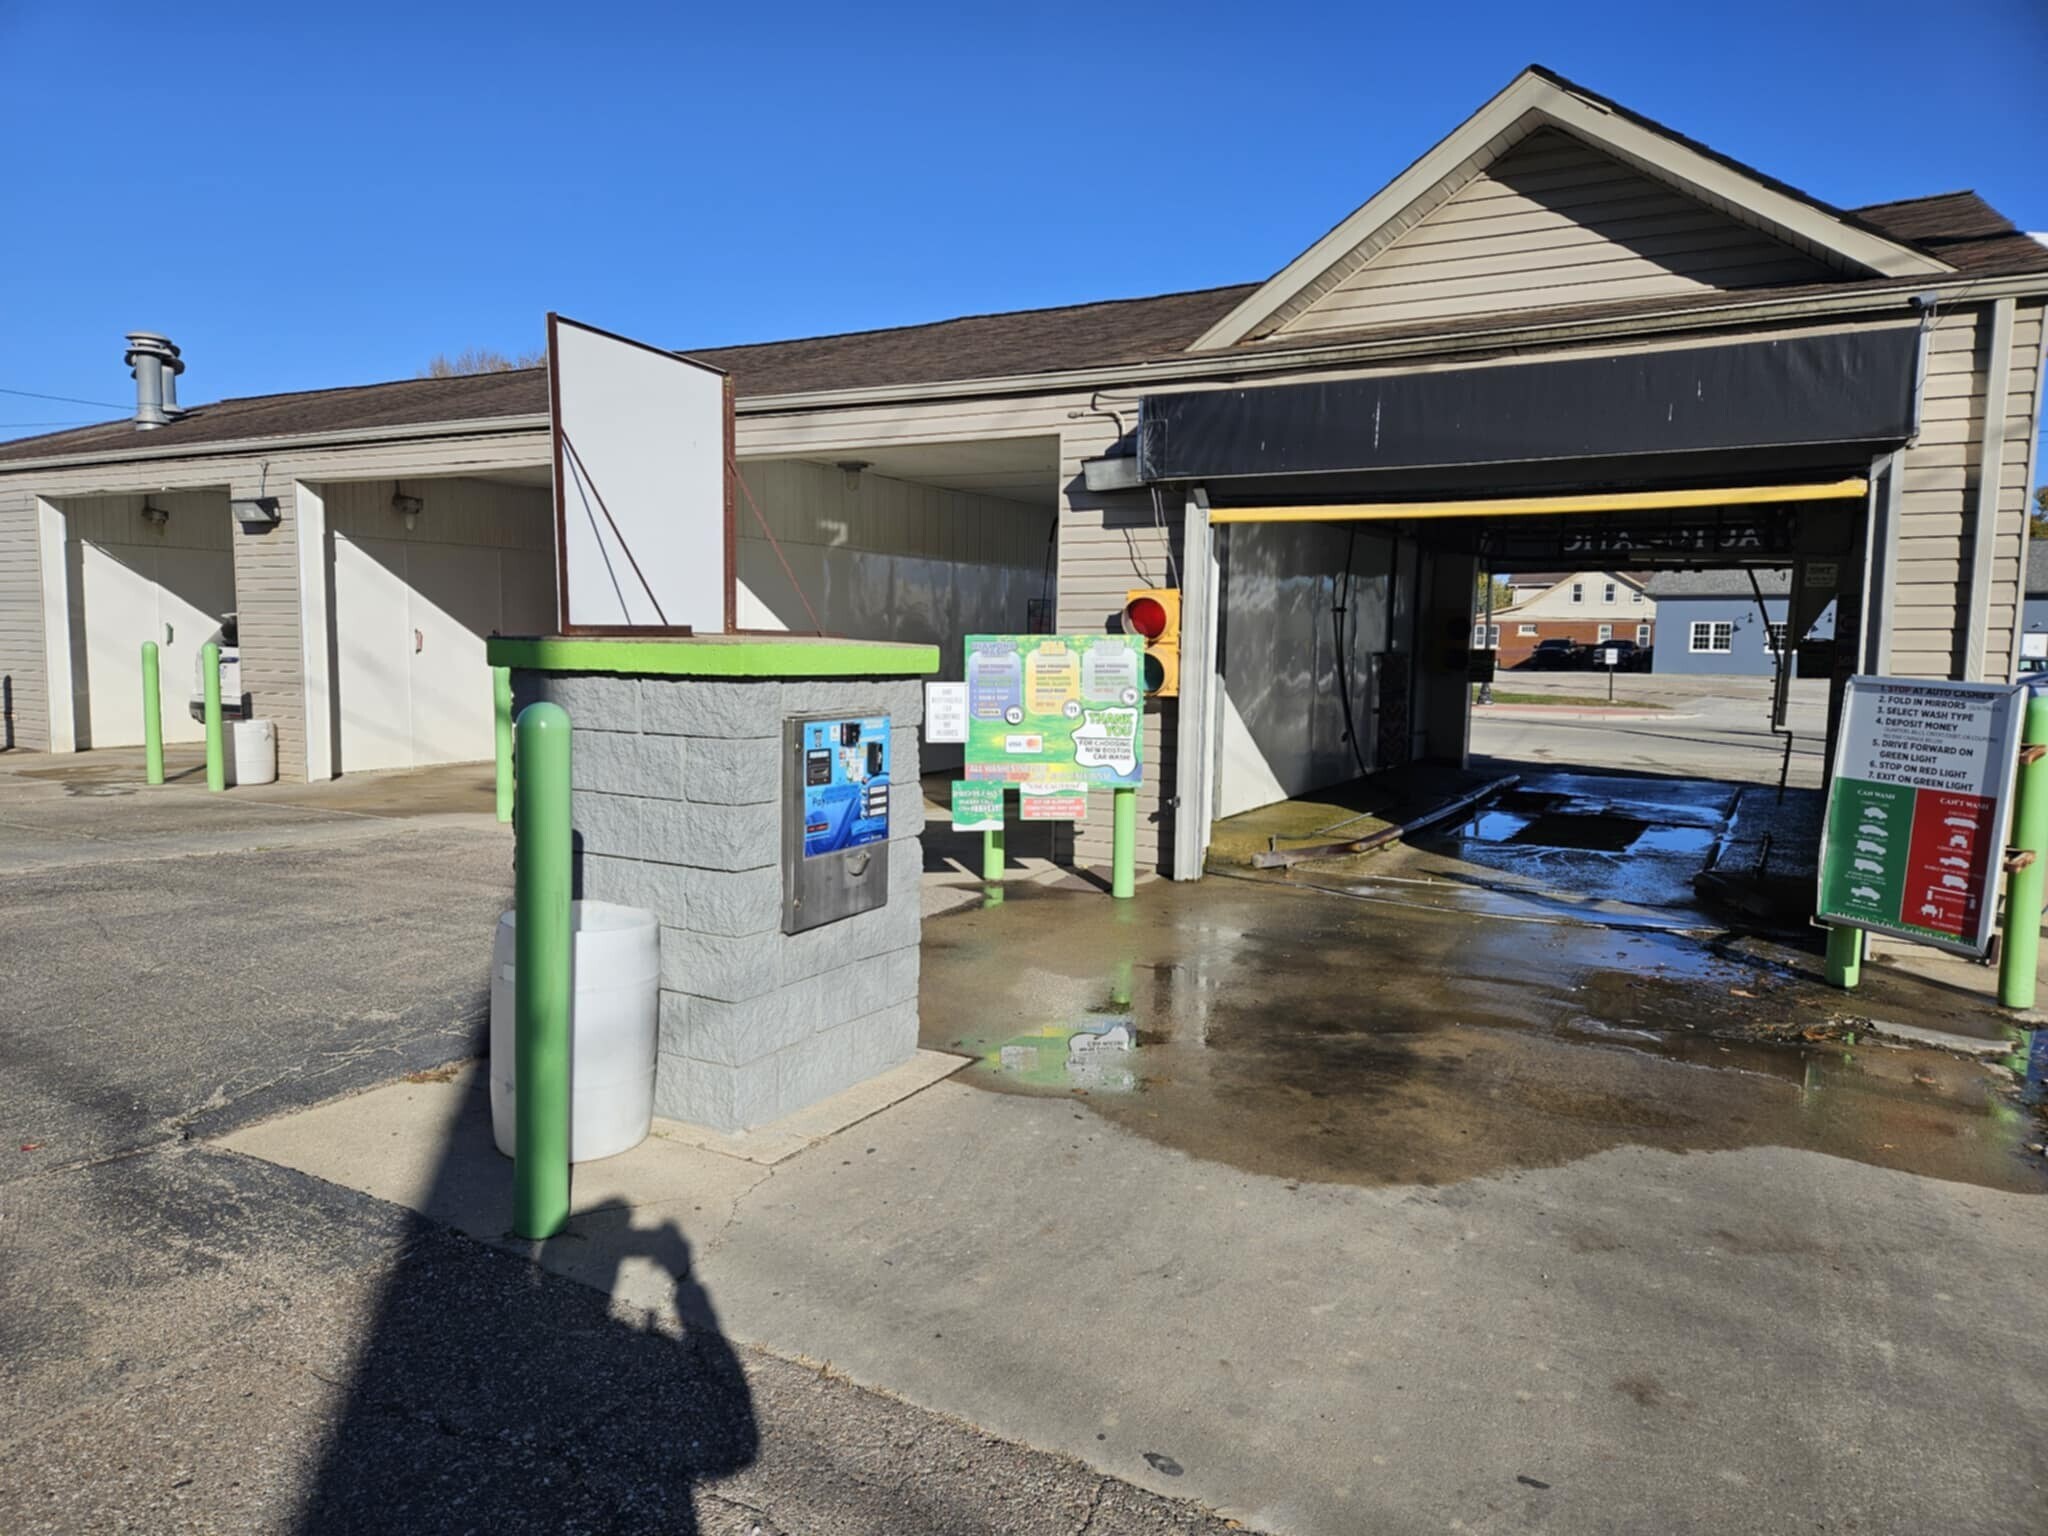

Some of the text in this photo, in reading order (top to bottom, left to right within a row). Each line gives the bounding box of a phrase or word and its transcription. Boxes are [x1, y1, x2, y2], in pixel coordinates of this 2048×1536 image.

[1888, 686, 1911, 694] STOP
[1912, 688, 1925, 696] AT
[1926, 688, 1952, 698] AUTO
[1953, 690, 1994, 700] CASHIER
[1888, 696, 1912, 706] FOLD
[1913, 698, 1922, 706] IN
[1924, 699, 1966, 710] MIRRORS
[1087, 712, 1134, 725] THANK
[1886, 706, 1918, 718] SELECT
[1920, 710, 1948, 720] WASH
[1950, 712, 1974, 722] TYPE
[1105, 724, 1133, 737] YOU
[1875, 717, 1959, 732] 4. DEPOSIT MONEY
[1872, 739, 1974, 757] 5. DRIVE FORWARD ON
[1879, 750, 1938, 764] GREEN LIGHT
[1869, 760, 1968, 780] 6. STOP ON RED LIGHT
[1868, 771, 1974, 792] 7. EXIT ON GREEN LIGHT
